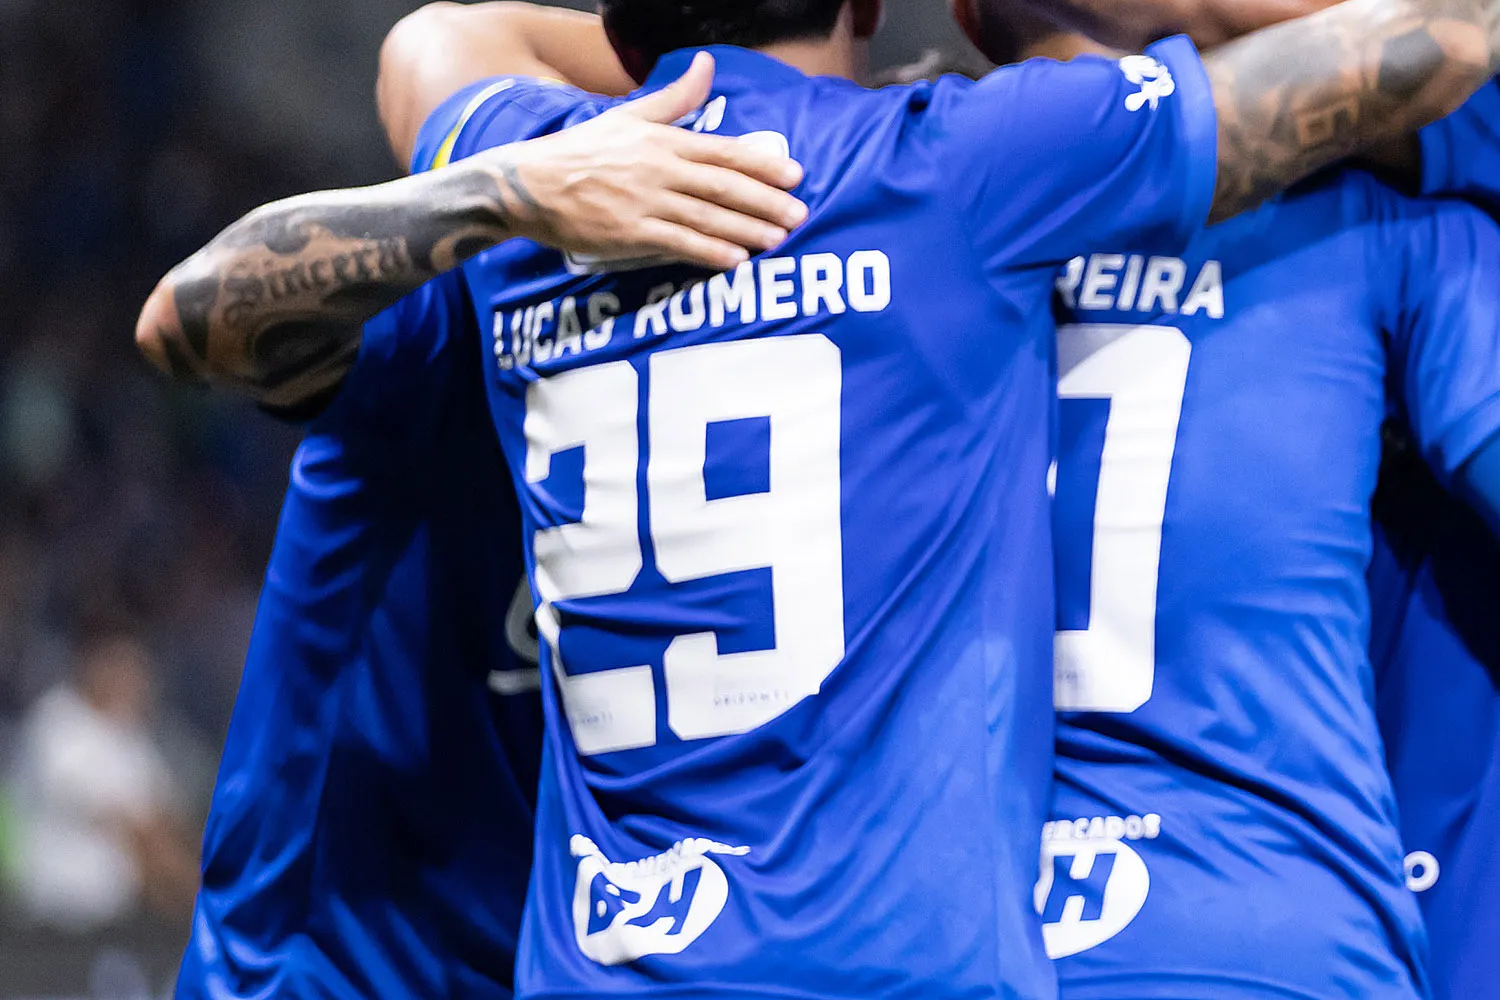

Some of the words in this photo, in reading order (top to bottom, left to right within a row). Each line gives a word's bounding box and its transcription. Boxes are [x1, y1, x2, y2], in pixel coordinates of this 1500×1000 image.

[493, 289, 620, 371] LUCAS
[632, 250, 892, 339] ROMERO
[524, 332, 845, 757] 29
